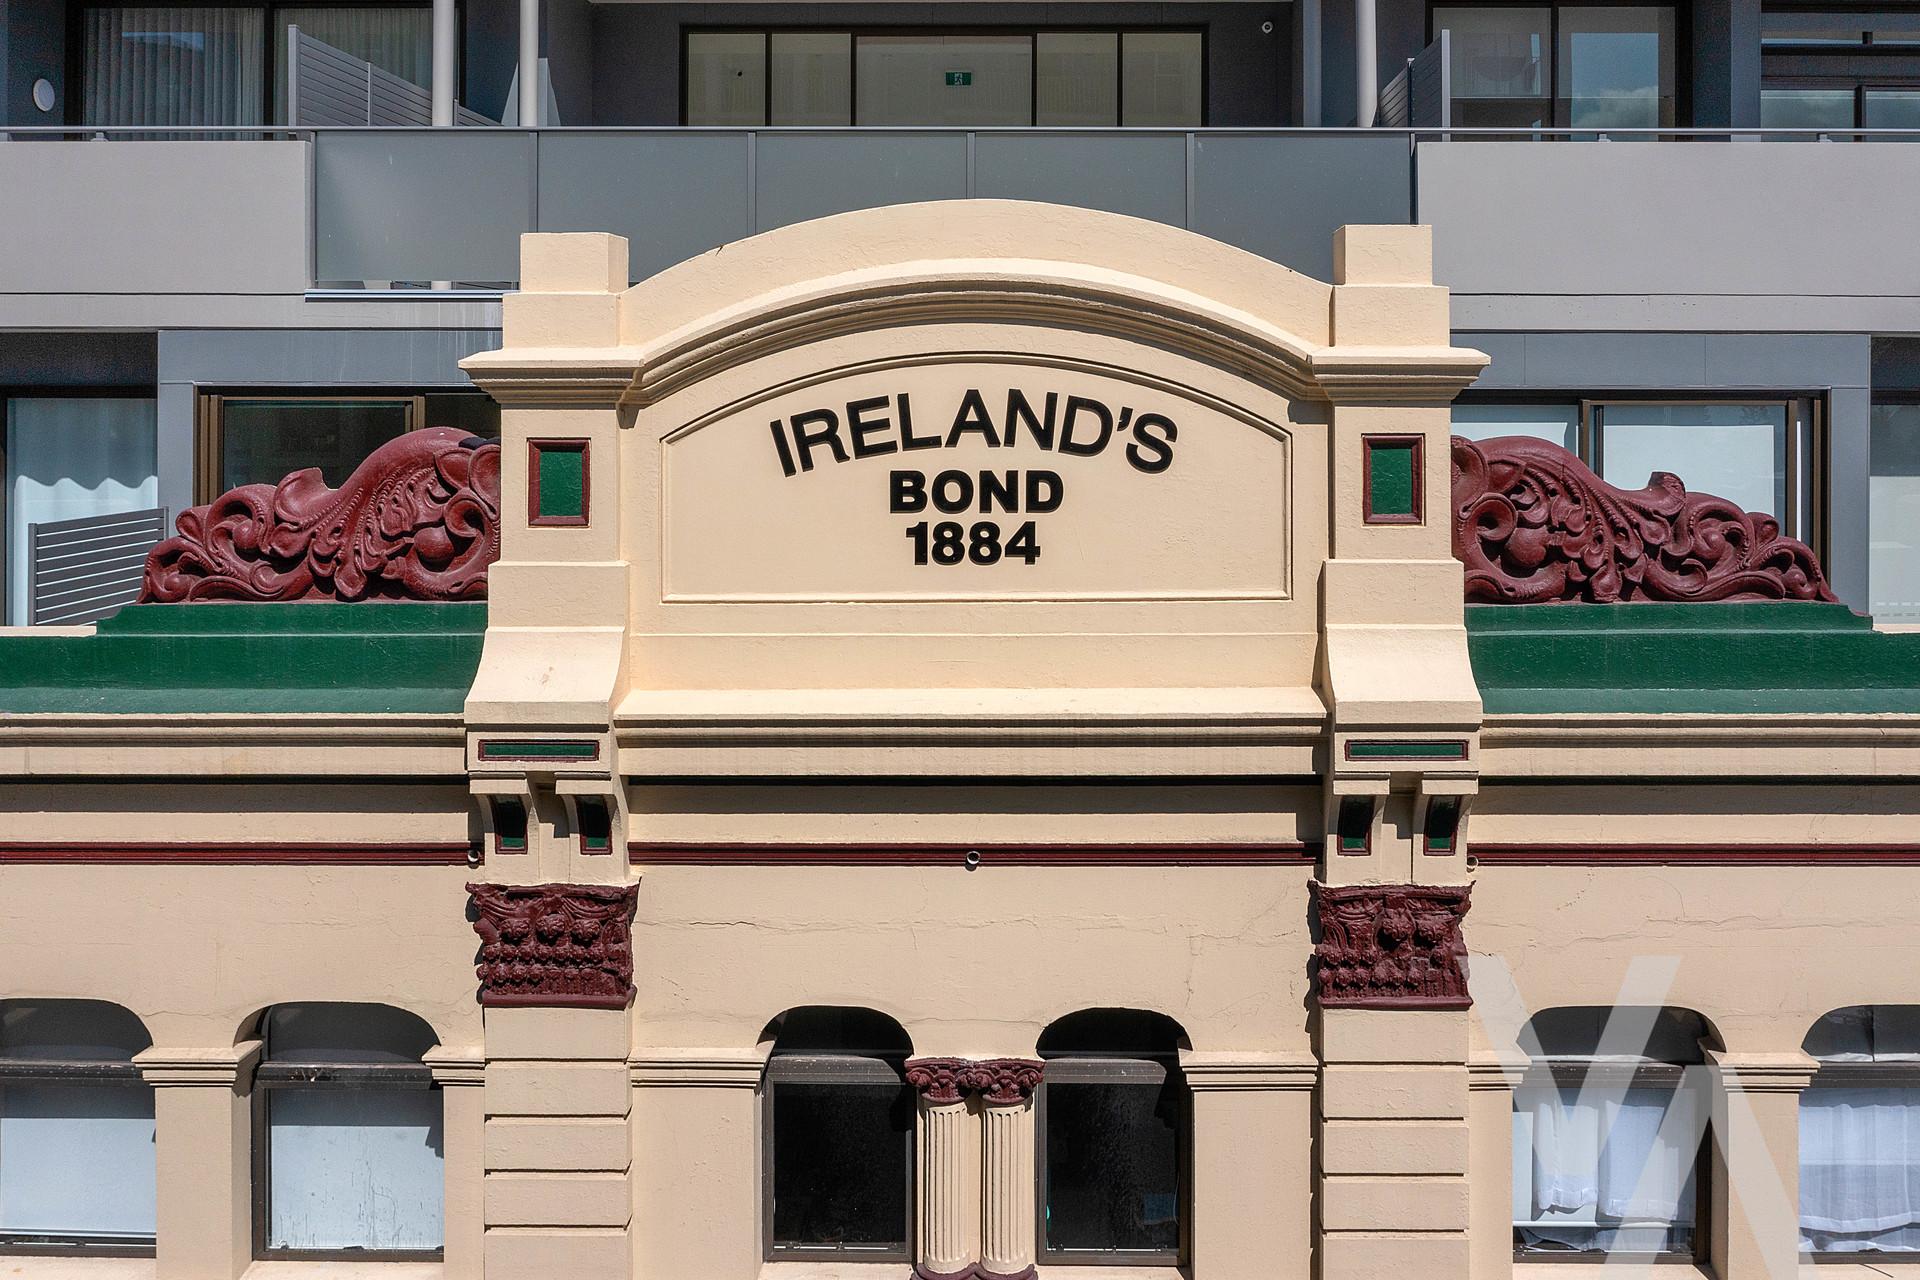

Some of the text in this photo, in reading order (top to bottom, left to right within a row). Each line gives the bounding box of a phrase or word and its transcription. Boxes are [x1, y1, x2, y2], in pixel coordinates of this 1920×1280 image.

[770, 388, 1178, 478] IRELAND'S
[890, 470, 1063, 514] BOND
[906, 521, 1040, 566] 1884
